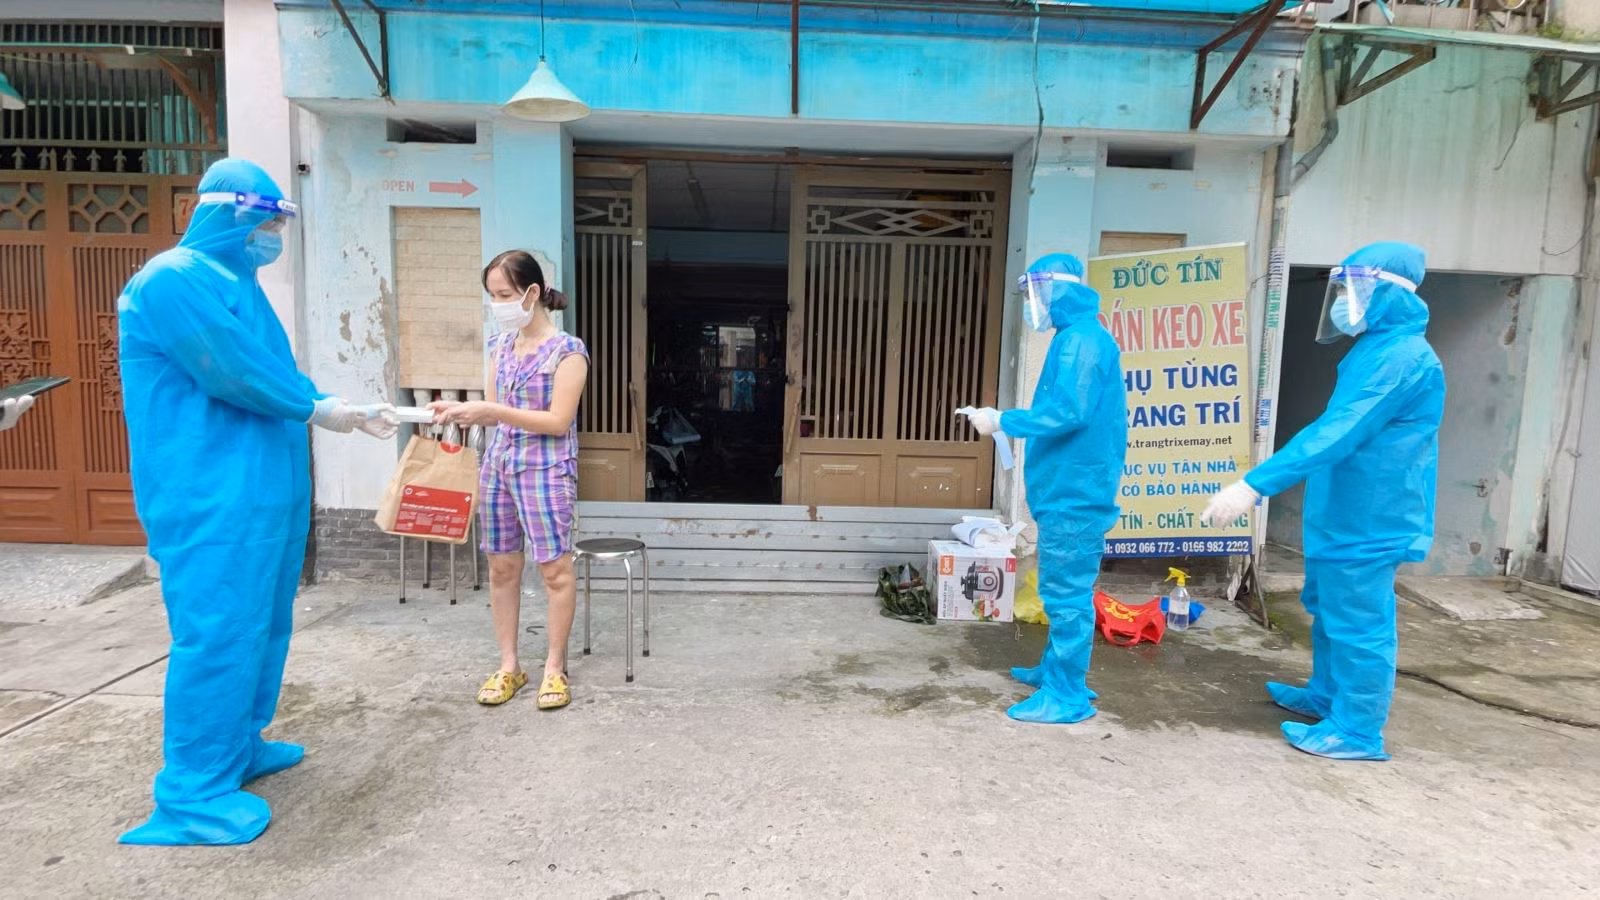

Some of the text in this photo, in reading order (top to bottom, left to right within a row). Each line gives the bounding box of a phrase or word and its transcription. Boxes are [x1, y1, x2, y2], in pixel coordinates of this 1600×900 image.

[382, 180, 415, 192] OPEN
[1113, 253, 1223, 289] ĐỨC TÍN
[1151, 304, 1205, 351] KEO
[1211, 300, 1245, 347] XE
[1124, 369, 1152, 396] HỤ
[1162, 360, 1238, 390] TÙNG
[1127, 404, 1187, 428] ANG
[1195, 395, 1241, 425] TRÍ
[1148, 463, 1167, 478] VỤ
[1172, 458, 1201, 476] TẬN
[1121, 481, 1140, 497] CÓ
[1146, 479, 1176, 496] BẢO
[1120, 509, 1143, 530] TÍN
[1157, 506, 1195, 529] CHẤT
[1114, 542, 1137, 555] 0932
[1139, 541, 1156, 553] 066
[1157, 541, 1175, 553] 772
[1182, 540, 1205, 553] 0166
[1206, 540, 1224, 552] 982
